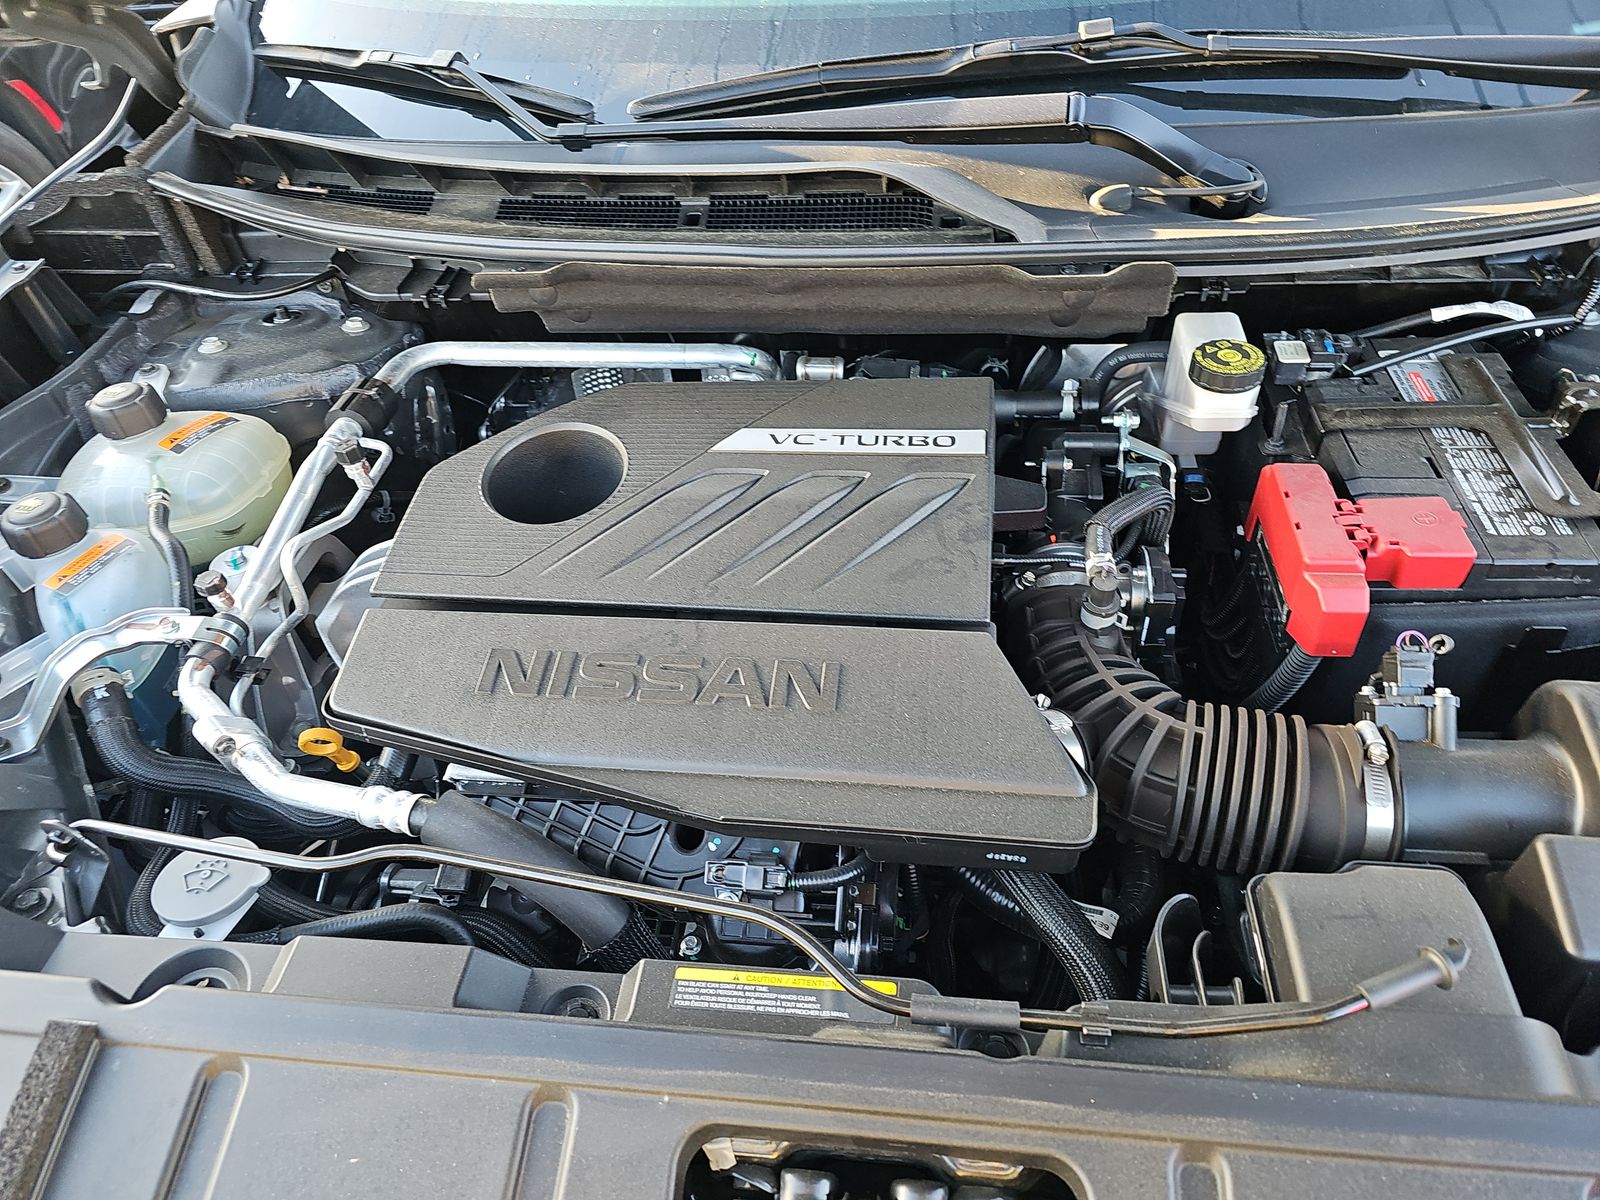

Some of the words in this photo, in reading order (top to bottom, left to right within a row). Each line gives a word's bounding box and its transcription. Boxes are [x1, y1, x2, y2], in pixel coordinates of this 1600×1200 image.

[769, 433, 956, 448] VC-TURBO
[475, 648, 841, 711] NISSAN
[745, 975, 783, 985] CAUTION
[792, 978, 837, 988] ATTENTION
[683, 994, 717, 1002] VENTILATEUR
[717, 989, 744, 997] PERSONAL
[785, 1008, 820, 1016] APPROCHER
